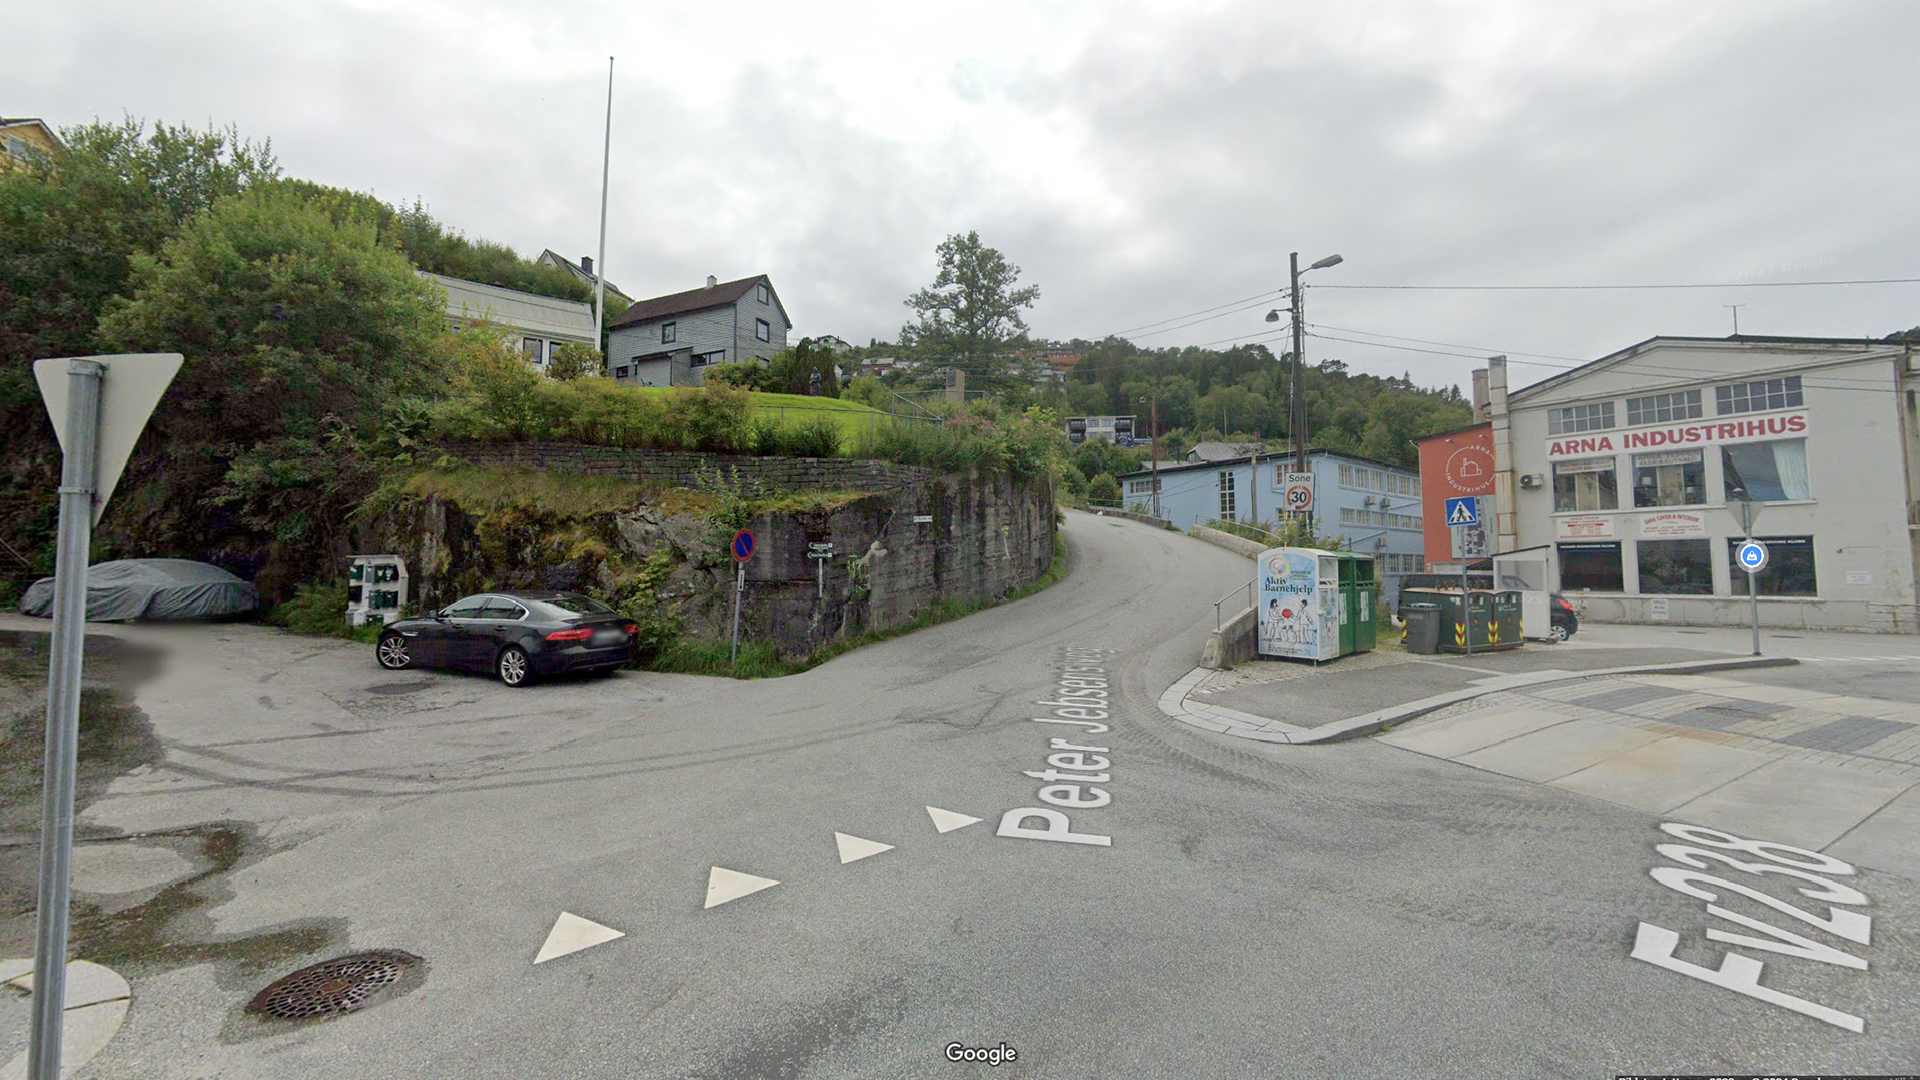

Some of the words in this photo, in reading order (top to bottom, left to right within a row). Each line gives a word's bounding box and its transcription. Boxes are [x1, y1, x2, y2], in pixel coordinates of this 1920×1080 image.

[1549, 436, 1614, 456] ARNA
[1623, 415, 1807, 449] INDUSTRIHUS
[1469, 444, 1491, 455] ARNA
[1288, 474, 1312, 482] Sone
[1445, 472, 1491, 493] INDUSTRIHUS
[1291, 491, 1308, 503] 30
[1264, 576, 1288, 585] Aktiv
[1264, 584, 1313, 596] Barnehjelp
